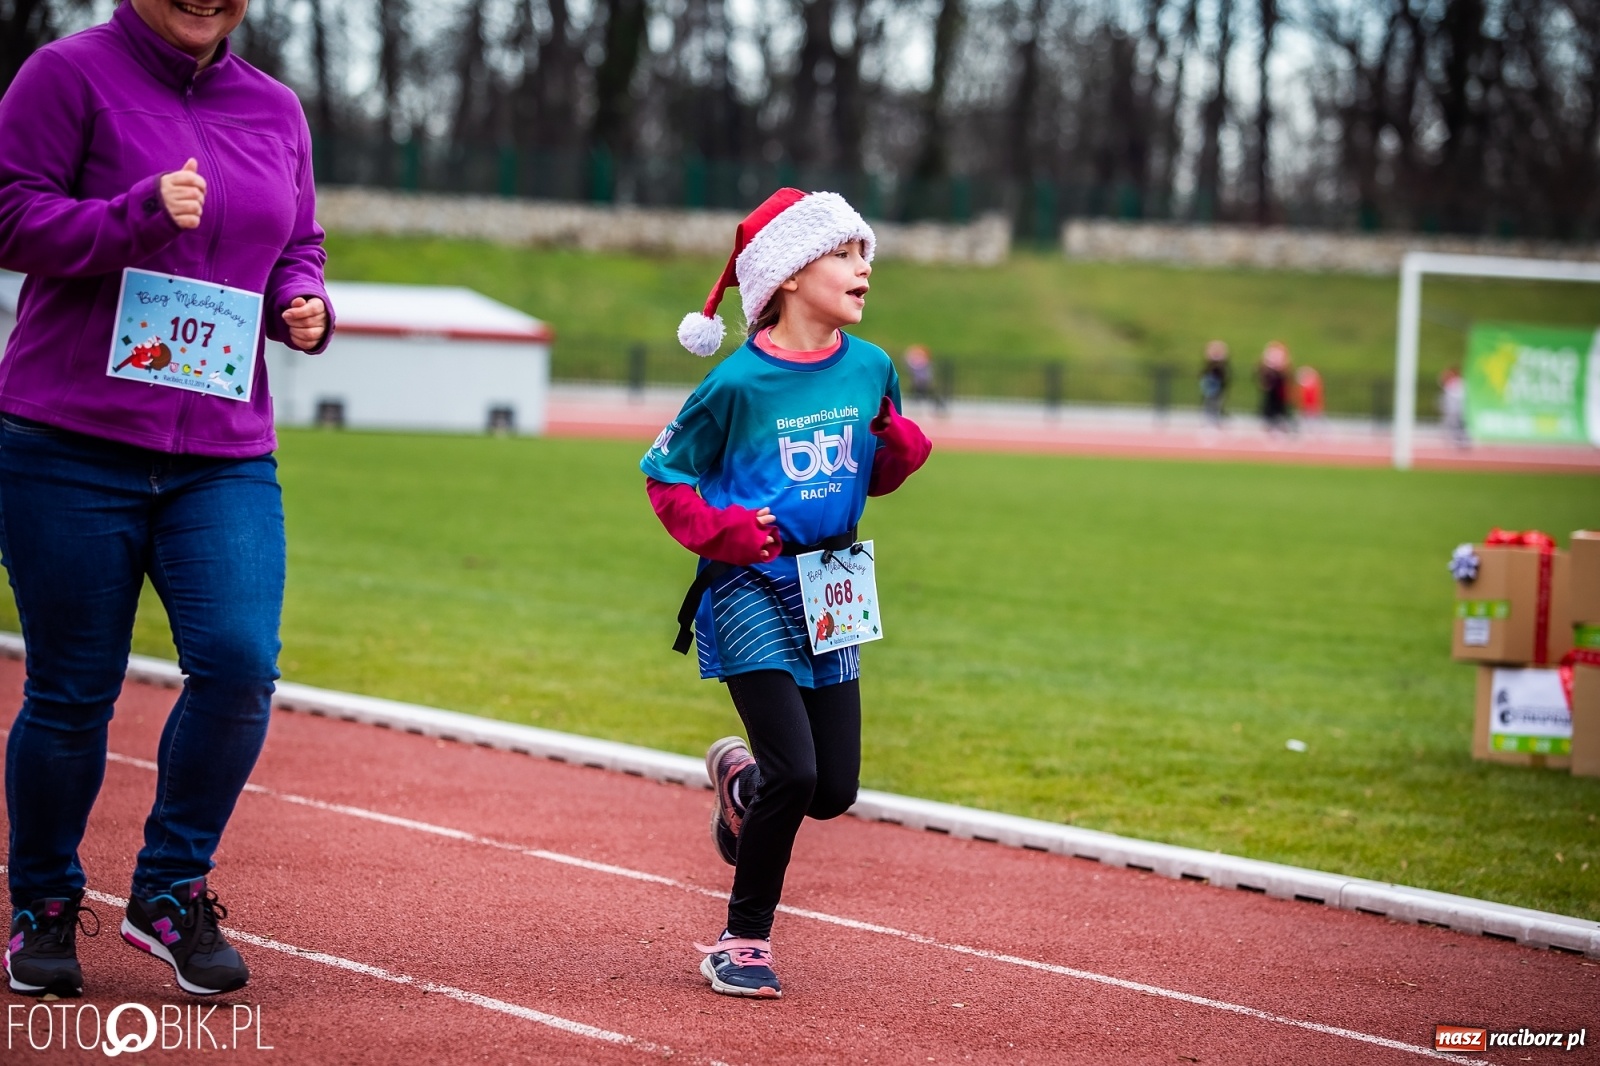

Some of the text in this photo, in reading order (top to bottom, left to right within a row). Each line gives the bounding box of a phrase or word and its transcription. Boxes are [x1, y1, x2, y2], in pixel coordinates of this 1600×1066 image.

[135, 291, 171, 307] Bieg
[170, 316, 216, 348] 107
[776, 405, 860, 430] BiegamBoLubię
[778, 424, 859, 482] bbl
[825, 578, 853, 608] 068
[152, 916, 181, 946] N
